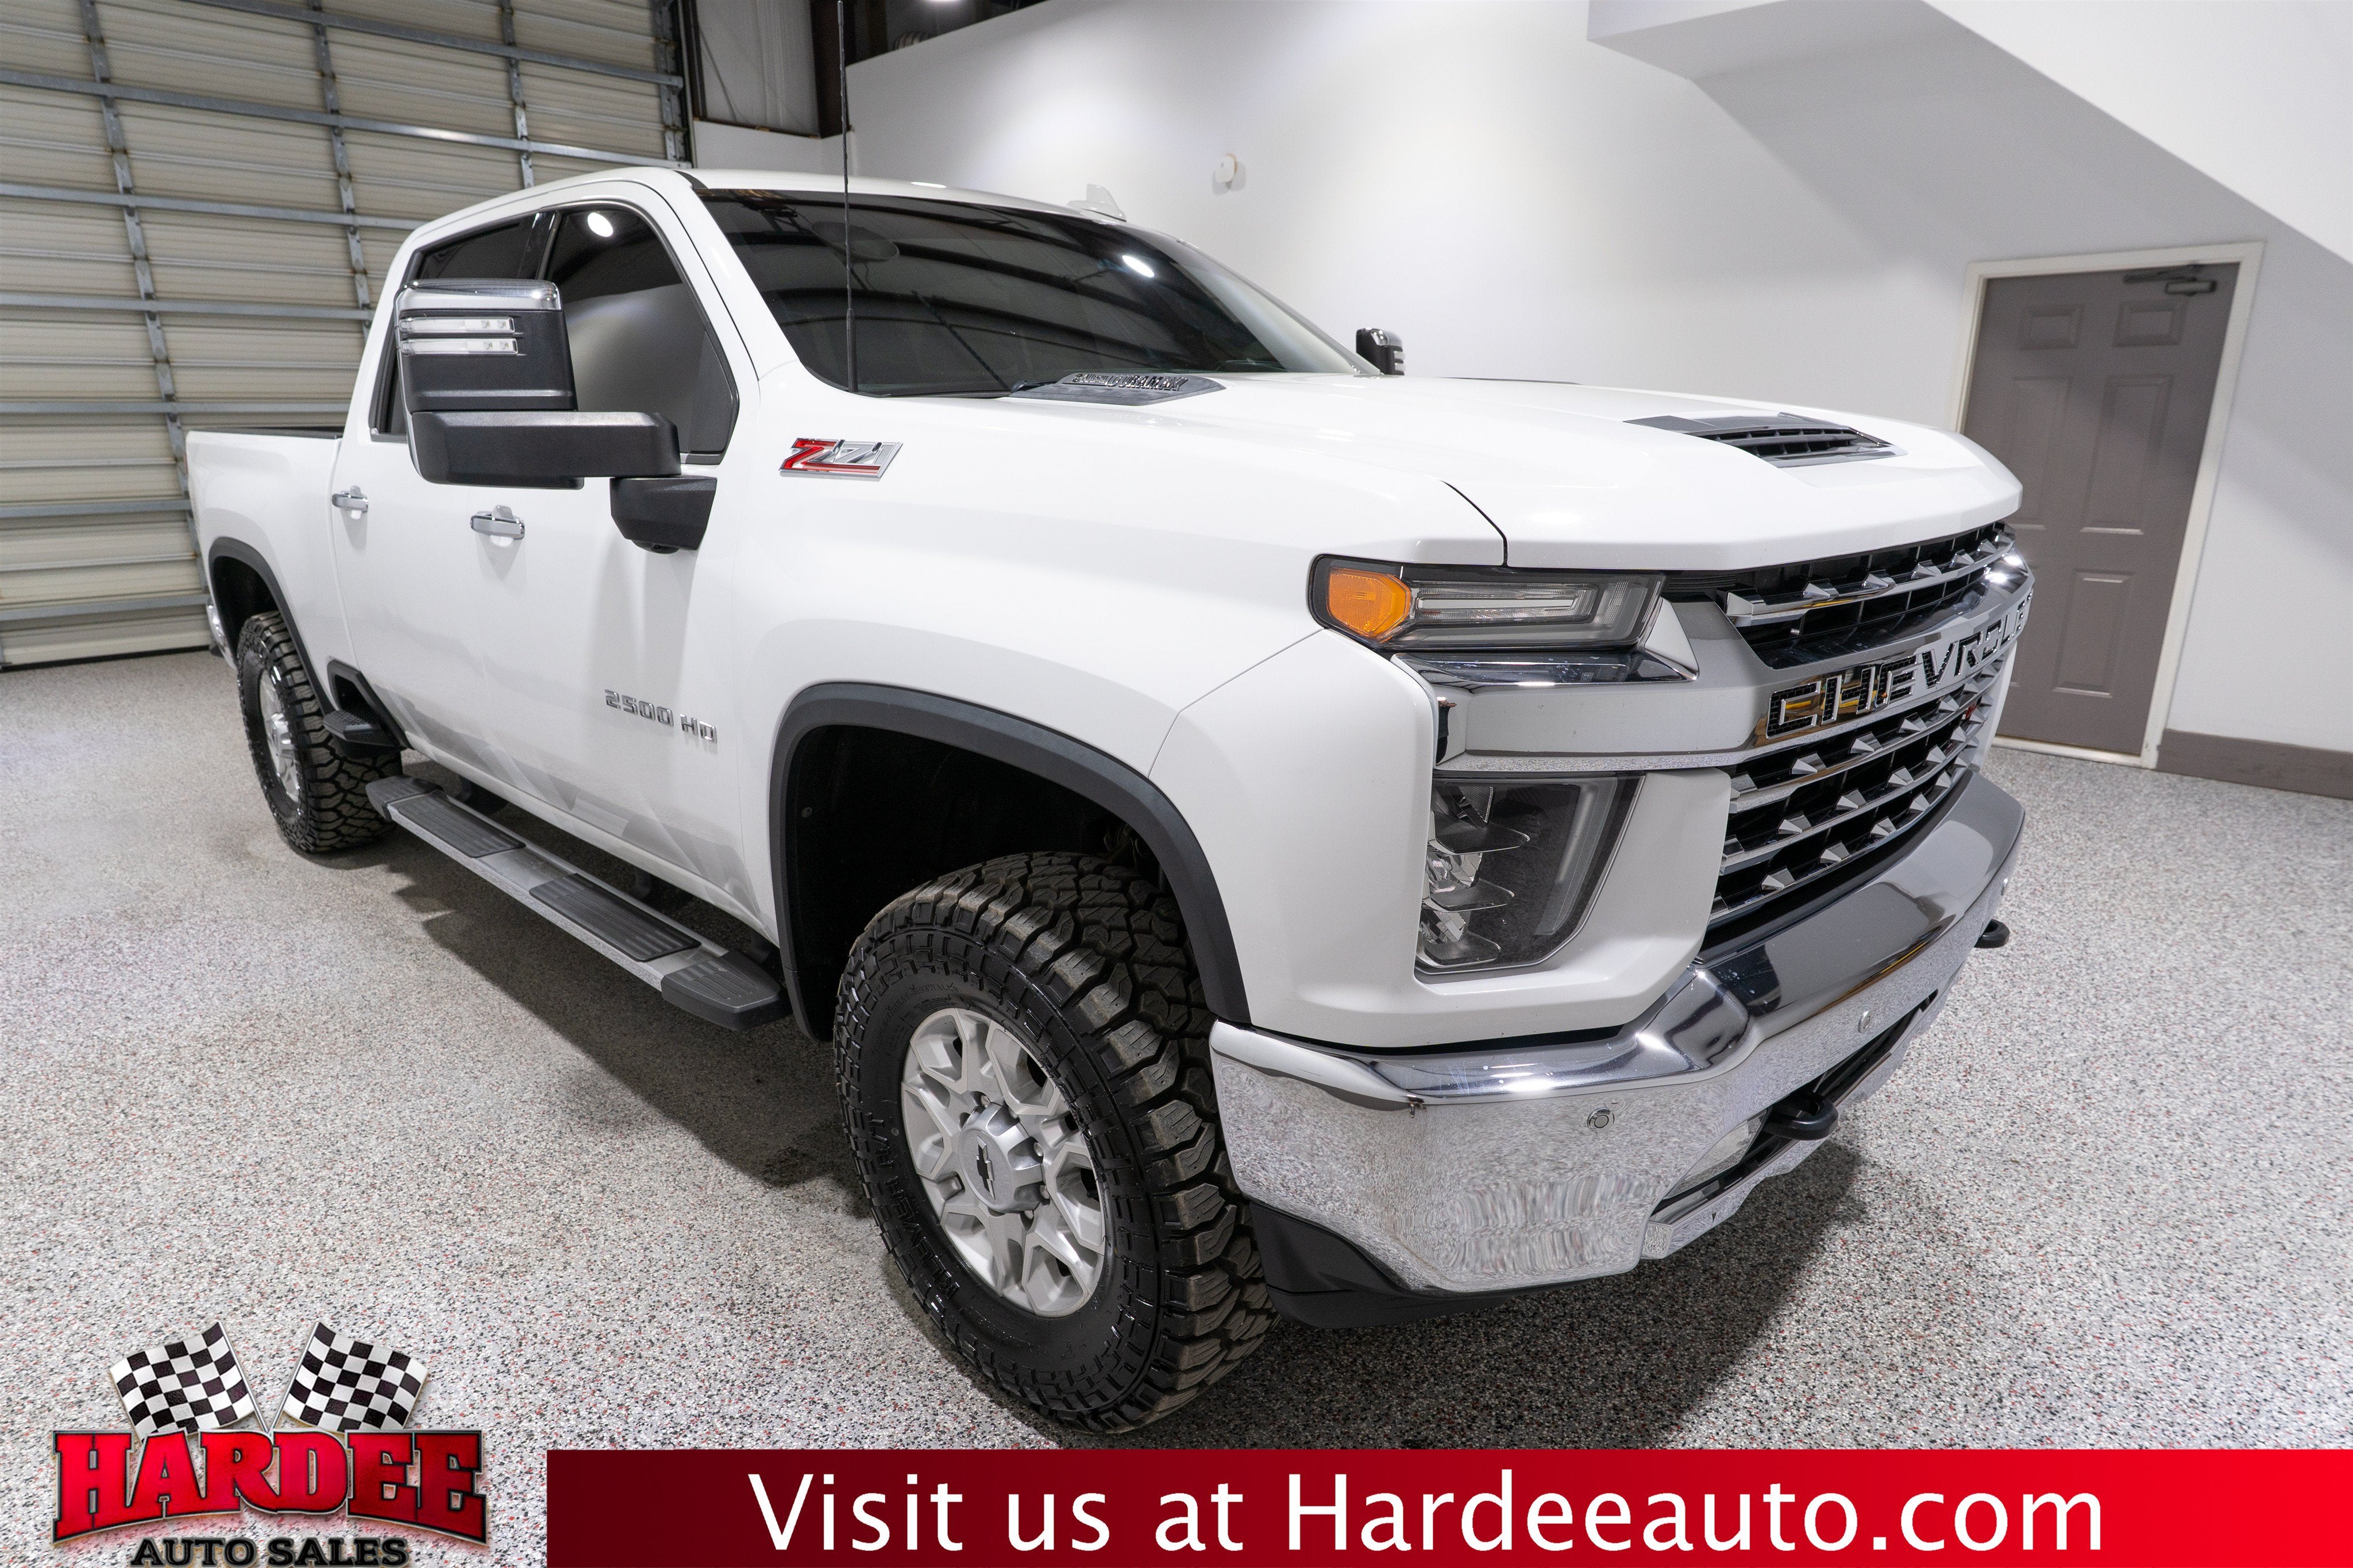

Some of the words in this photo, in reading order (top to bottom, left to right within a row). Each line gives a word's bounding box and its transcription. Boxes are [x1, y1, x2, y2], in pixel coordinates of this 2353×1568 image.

[1108, 374, 1189, 391] DURAMAX
[604, 689, 674, 727] 2500
[680, 713, 718, 744] HD
